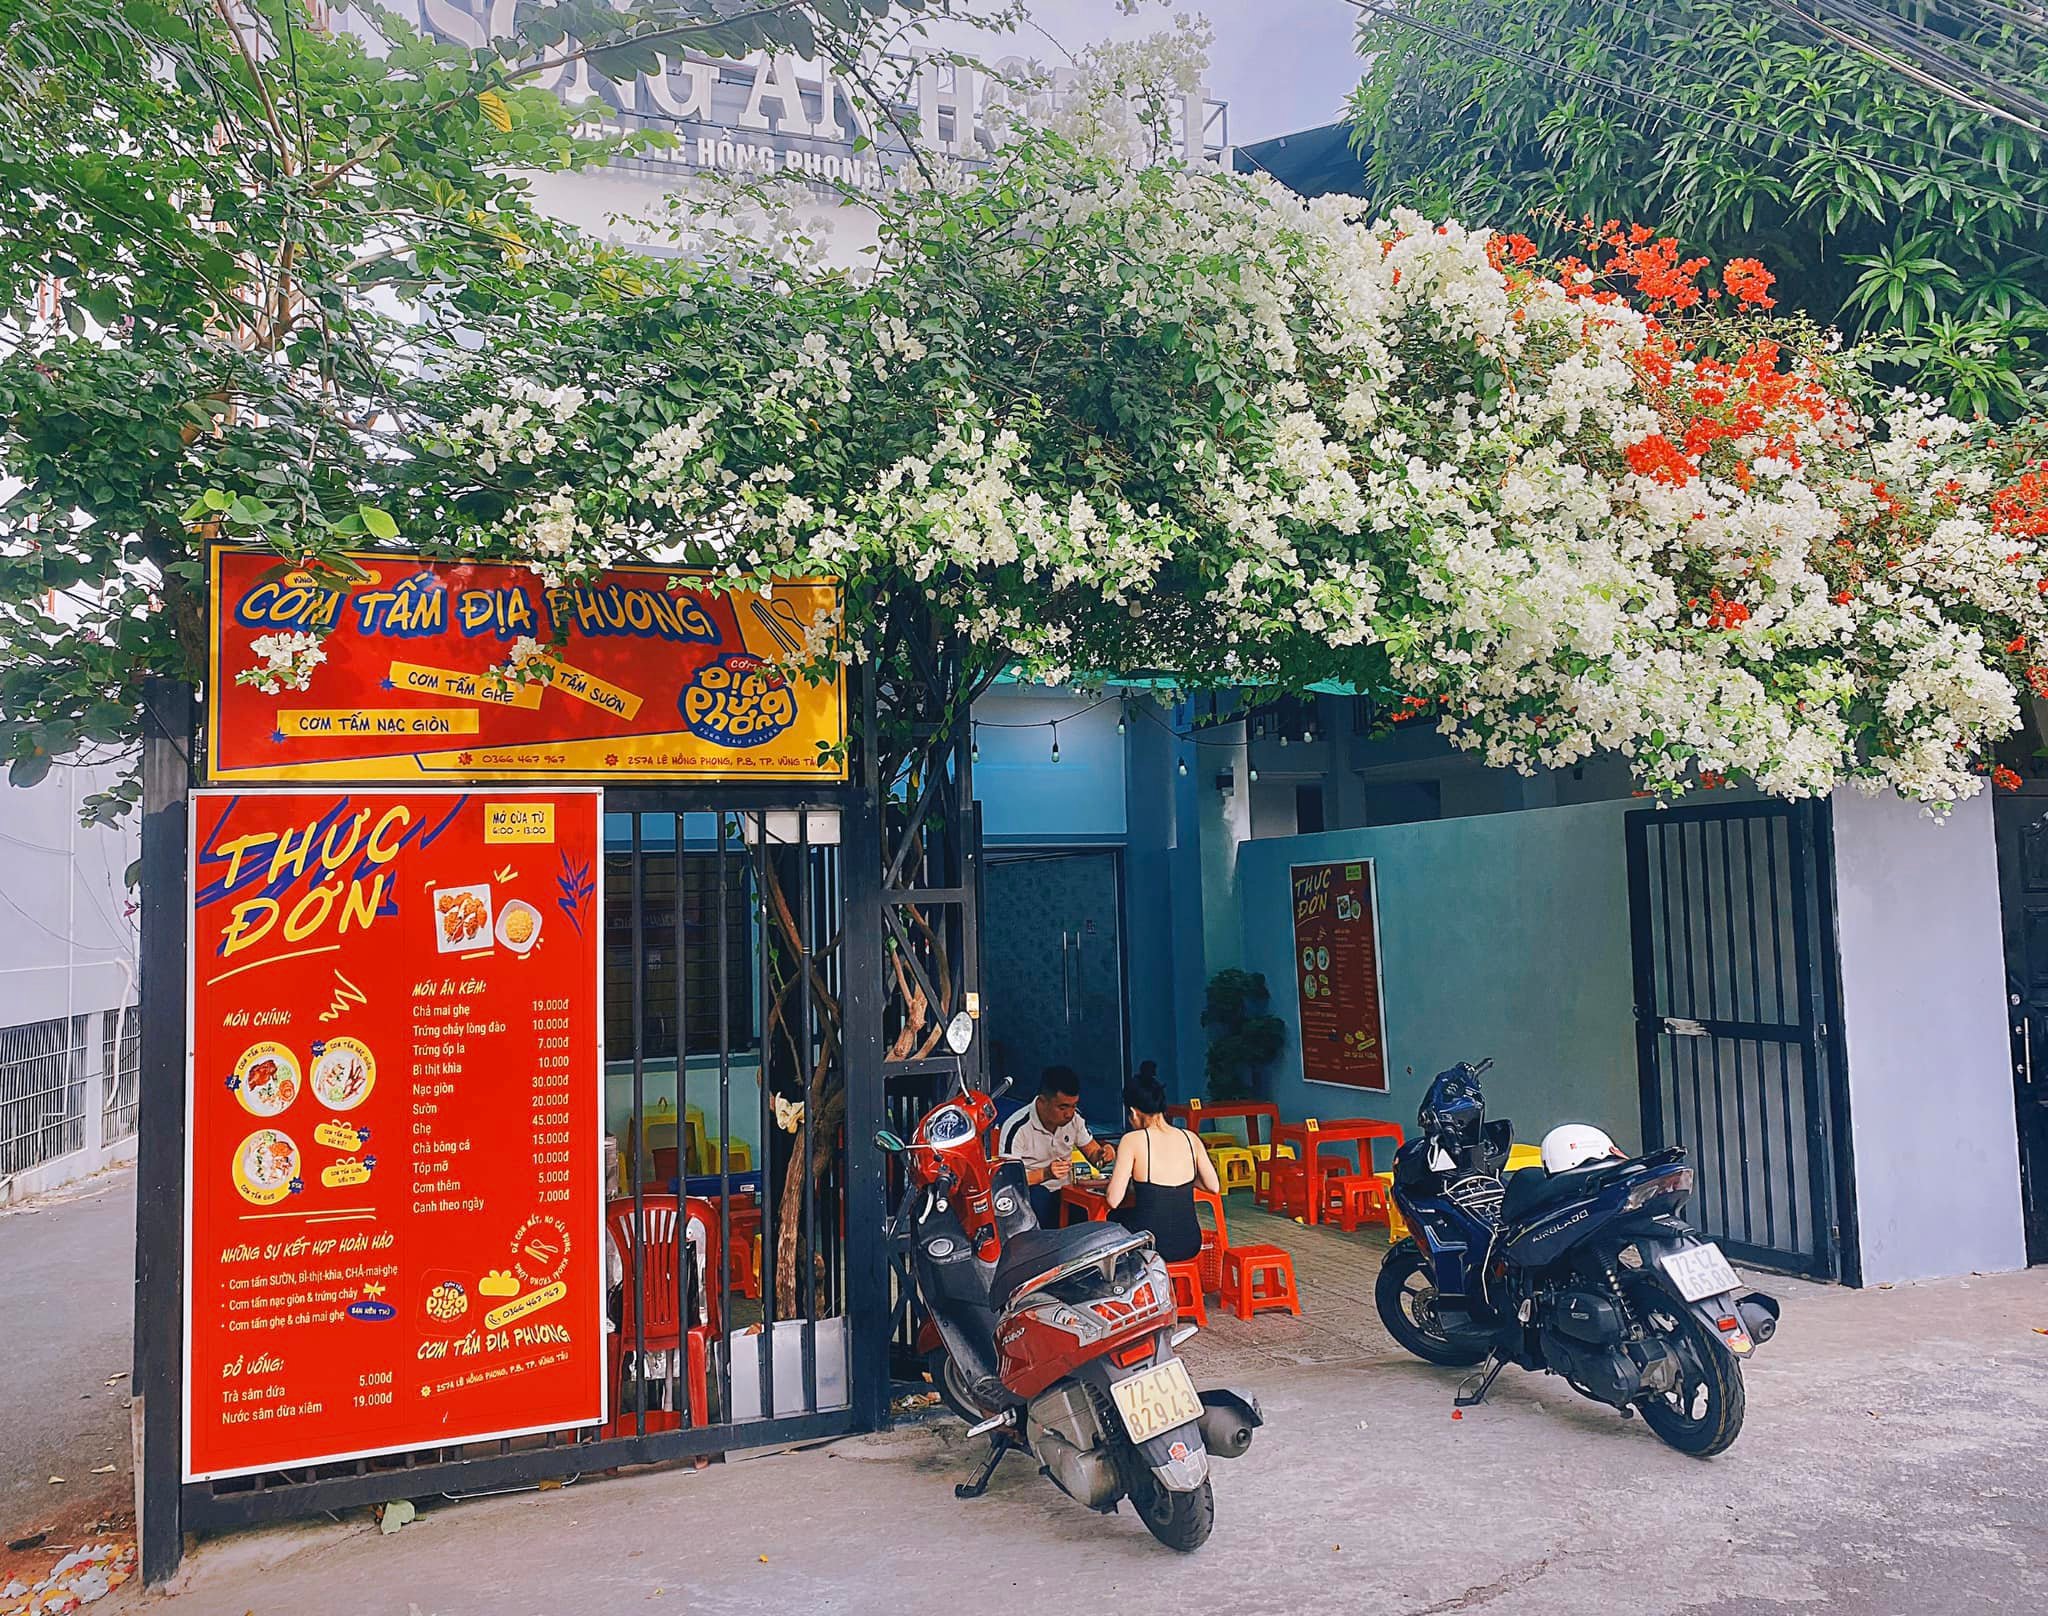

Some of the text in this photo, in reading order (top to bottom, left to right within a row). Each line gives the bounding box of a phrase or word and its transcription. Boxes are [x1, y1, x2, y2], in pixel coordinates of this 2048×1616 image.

[698, 126, 775, 173] HỒNG
[359, 573, 441, 629] TẤM
[460, 588, 530, 634] ĐỊA
[544, 585, 715, 637] PHƯƠNG
[408, 672, 515, 704] CƠM TẤM GHẸ
[560, 672, 625, 713] TẤM SƯỜN
[300, 712, 449, 734] CƠM TẤM NẠC GIÒN
[518, 755, 540, 763] 467
[628, 756, 653, 765] 257A
[657, 754, 668, 765] LÊ
[672, 753, 697, 765] HỒNG
[778, 756, 800, 767] VŨNG
[215, 805, 410, 889] THỰC
[1295, 868, 1331, 897] THỰC
[222, 874, 385, 957] ĐƠN
[412, 977, 487, 997] MÓN ĂN KÈM:
[413, 1004, 470, 1018] Chả mai ghẹ
[532, 998, 570, 1012] 19.000đ
[224, 1008, 292, 1027] MÓN CHÍNH:
[532, 1018, 570, 1031] 10.000đ
[413, 1021, 507, 1038] Trứng chảy lòng đào
[413, 1042, 465, 1057] Trứng ốp la
[538, 1036, 570, 1049] 7.000đ
[538, 1056, 570, 1068] 10.000
[413, 1065, 422, 1076] Bì
[425, 1064, 441, 1077] thịt
[532, 1074, 570, 1088] 30.000đ
[413, 1083, 454, 1097] Nạc giòn
[532, 1094, 570, 1107] 20.000đ
[413, 1103, 438, 1115] Sườn
[532, 1112, 570, 1126] 45.000đ
[413, 1122, 432, 1136] Ghẹ
[459, 1139, 470, 1151] cá
[532, 1132, 570, 1145] 15.000đ
[532, 1151, 570, 1165] 10.000đ
[413, 1160, 449, 1175] Tóp mỡ
[538, 1170, 570, 1184] 5.000đ
[413, 1180, 461, 1194] Cơm thêm
[538, 1189, 570, 1203] 7.000đ
[413, 1197, 485, 1214] Canh theo ngày
[221, 1230, 395, 1264] NHỮNG SỰ KẾT HỢP HOÀN HẢO
[230, 1278, 250, 1291] Cơm
[252, 1275, 268, 1288] tấm
[230, 1299, 250, 1311] Cơm
[252, 1295, 268, 1309] tấm
[270, 1296, 286, 1308] nạc
[288, 1292, 305, 1307] giòn
[307, 1293, 313, 1303] &
[315, 1291, 337, 1304] trứng
[503, 1304, 525, 1319] 0366
[526, 1296, 543, 1308] 467
[230, 1320, 250, 1332] Cơm
[252, 1316, 268, 1329] tấm
[270, 1317, 286, 1330] ghẹ
[288, 1315, 293, 1326] &
[312, 1311, 328, 1322] mai
[330, 1310, 345, 1325] ghẹ
[417, 1323, 571, 1360] CƠM TẤM ĐỊA PHƯƠNG
[222, 1352, 285, 1379] ĐỒ UỐNG:
[359, 1372, 393, 1387] 5.000đ
[223, 1385, 286, 1404] Trà sâm dứa
[353, 1392, 393, 1408] 19.000đ
[223, 1402, 323, 1425] Nước sâm dừa xiêm
[1129, 1391, 1196, 1436] 829.43
